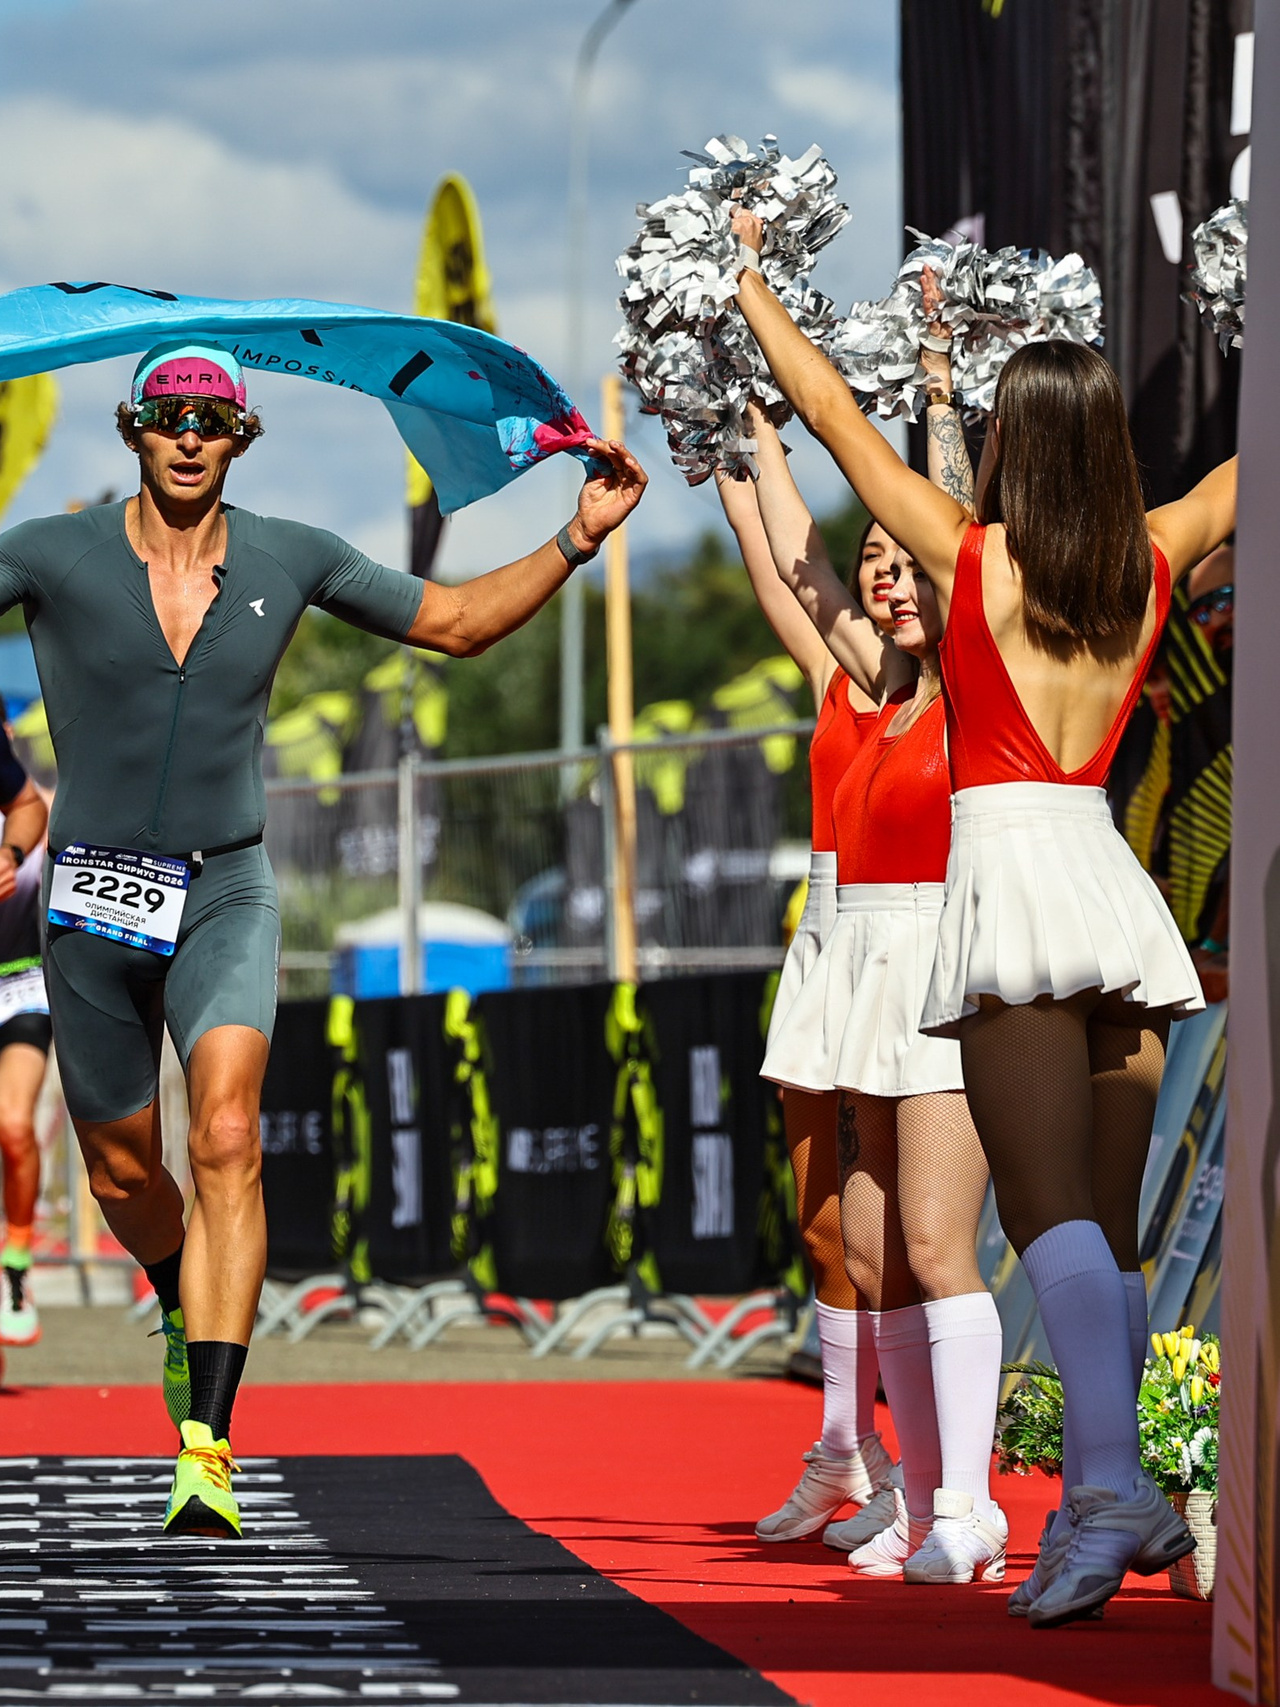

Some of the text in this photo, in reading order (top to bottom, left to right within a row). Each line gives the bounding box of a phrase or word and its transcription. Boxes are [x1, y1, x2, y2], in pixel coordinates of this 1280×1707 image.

[156, 373, 222, 385] EMRI
[231, 344, 373, 397] IMPOSSI
[62, 856, 114, 868] IRONSTAR
[116, 863, 156, 879] СИРИУС
[157, 874, 184, 886] 2026
[153, 860, 187, 872] SUPREME
[72, 871, 165, 914] 2229
[85, 901, 146, 924] ОЛИМПИЙСКАЯ
[90, 909, 139, 929] ДИСТАНЦИЯ
[95, 925, 124, 938] GRAND
[124, 933, 148, 946] FINAL
